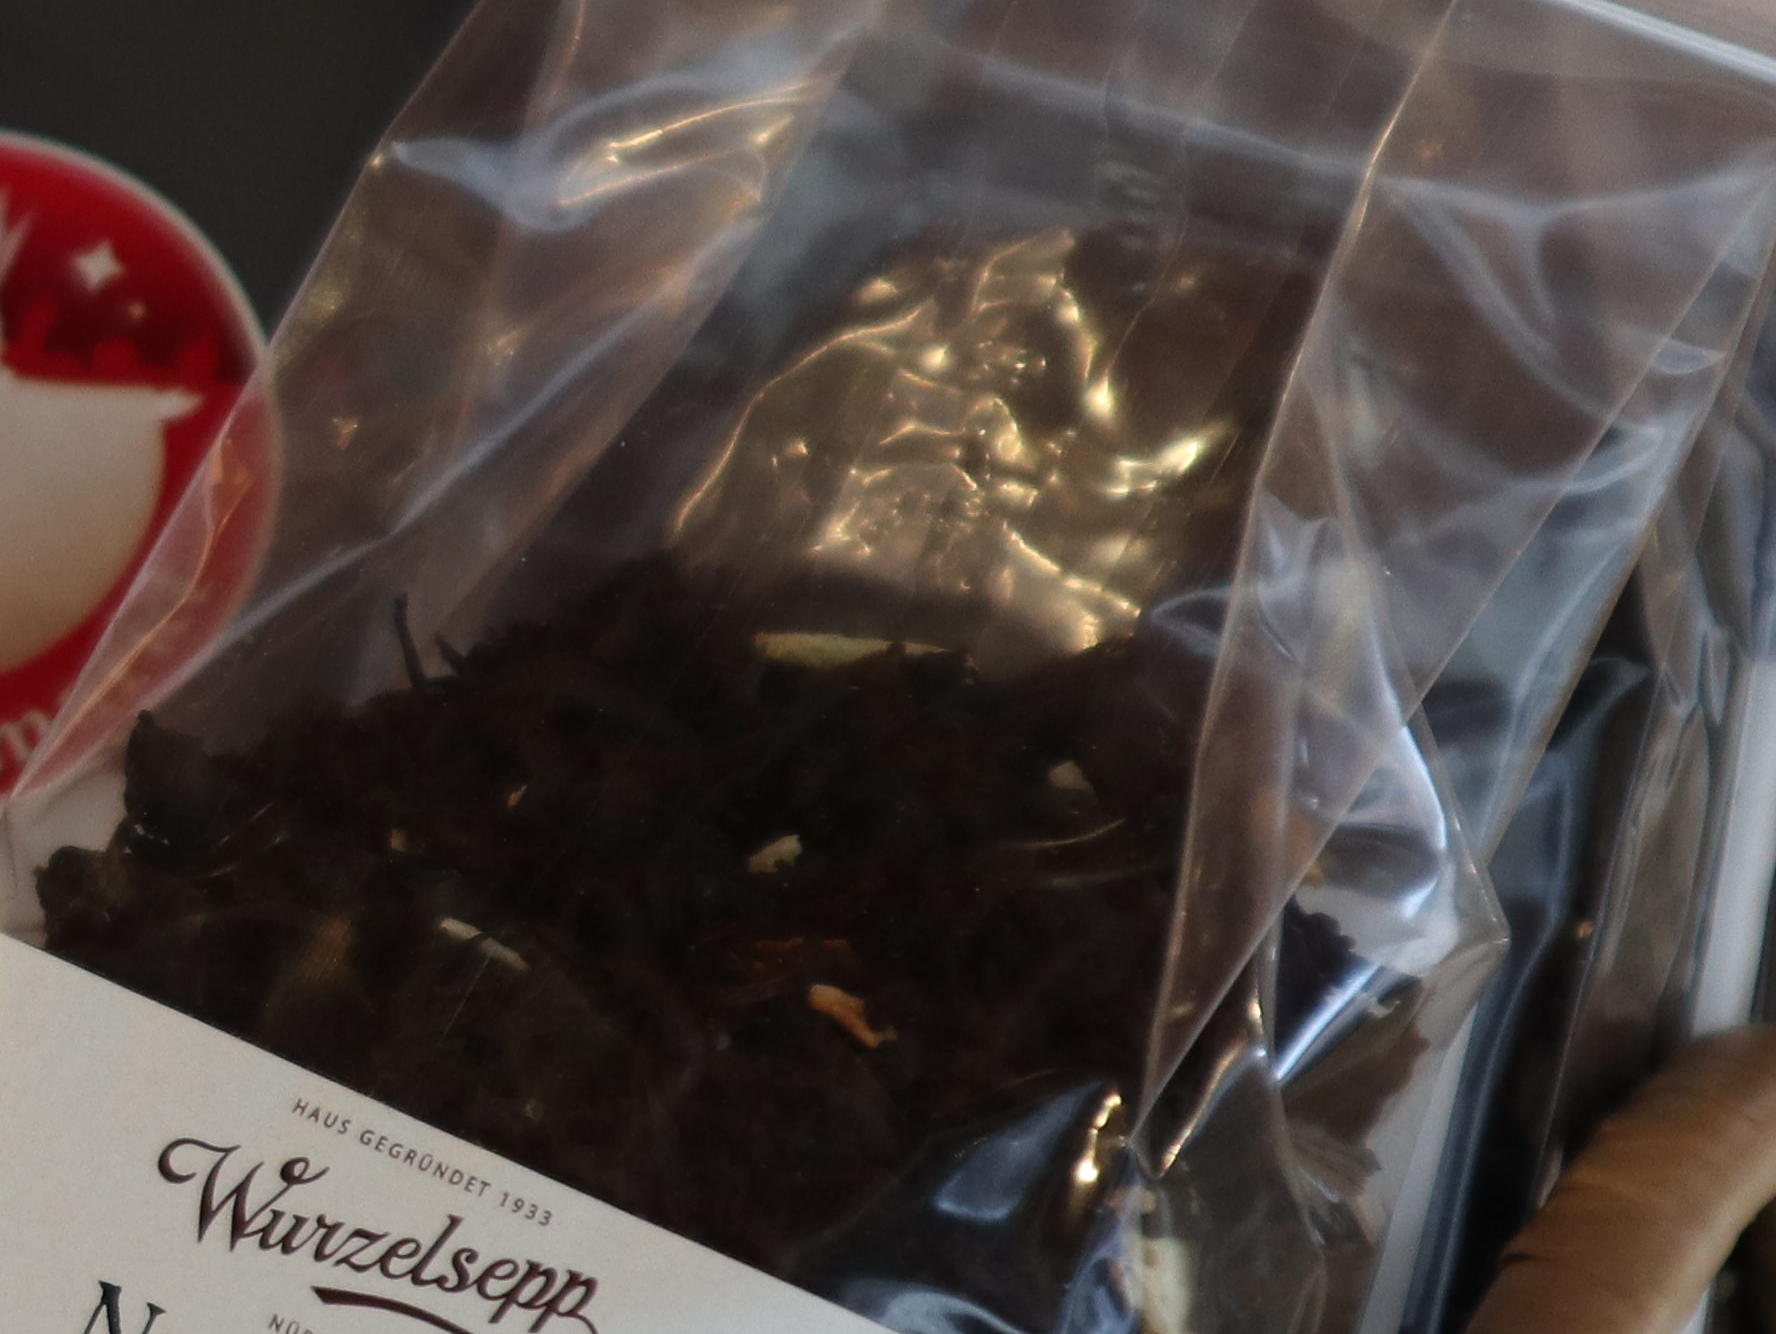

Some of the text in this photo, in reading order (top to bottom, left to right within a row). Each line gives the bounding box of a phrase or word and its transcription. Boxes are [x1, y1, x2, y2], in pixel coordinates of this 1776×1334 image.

[293, 1098, 554, 1227] HAUS GEGRÜNDET 1933
